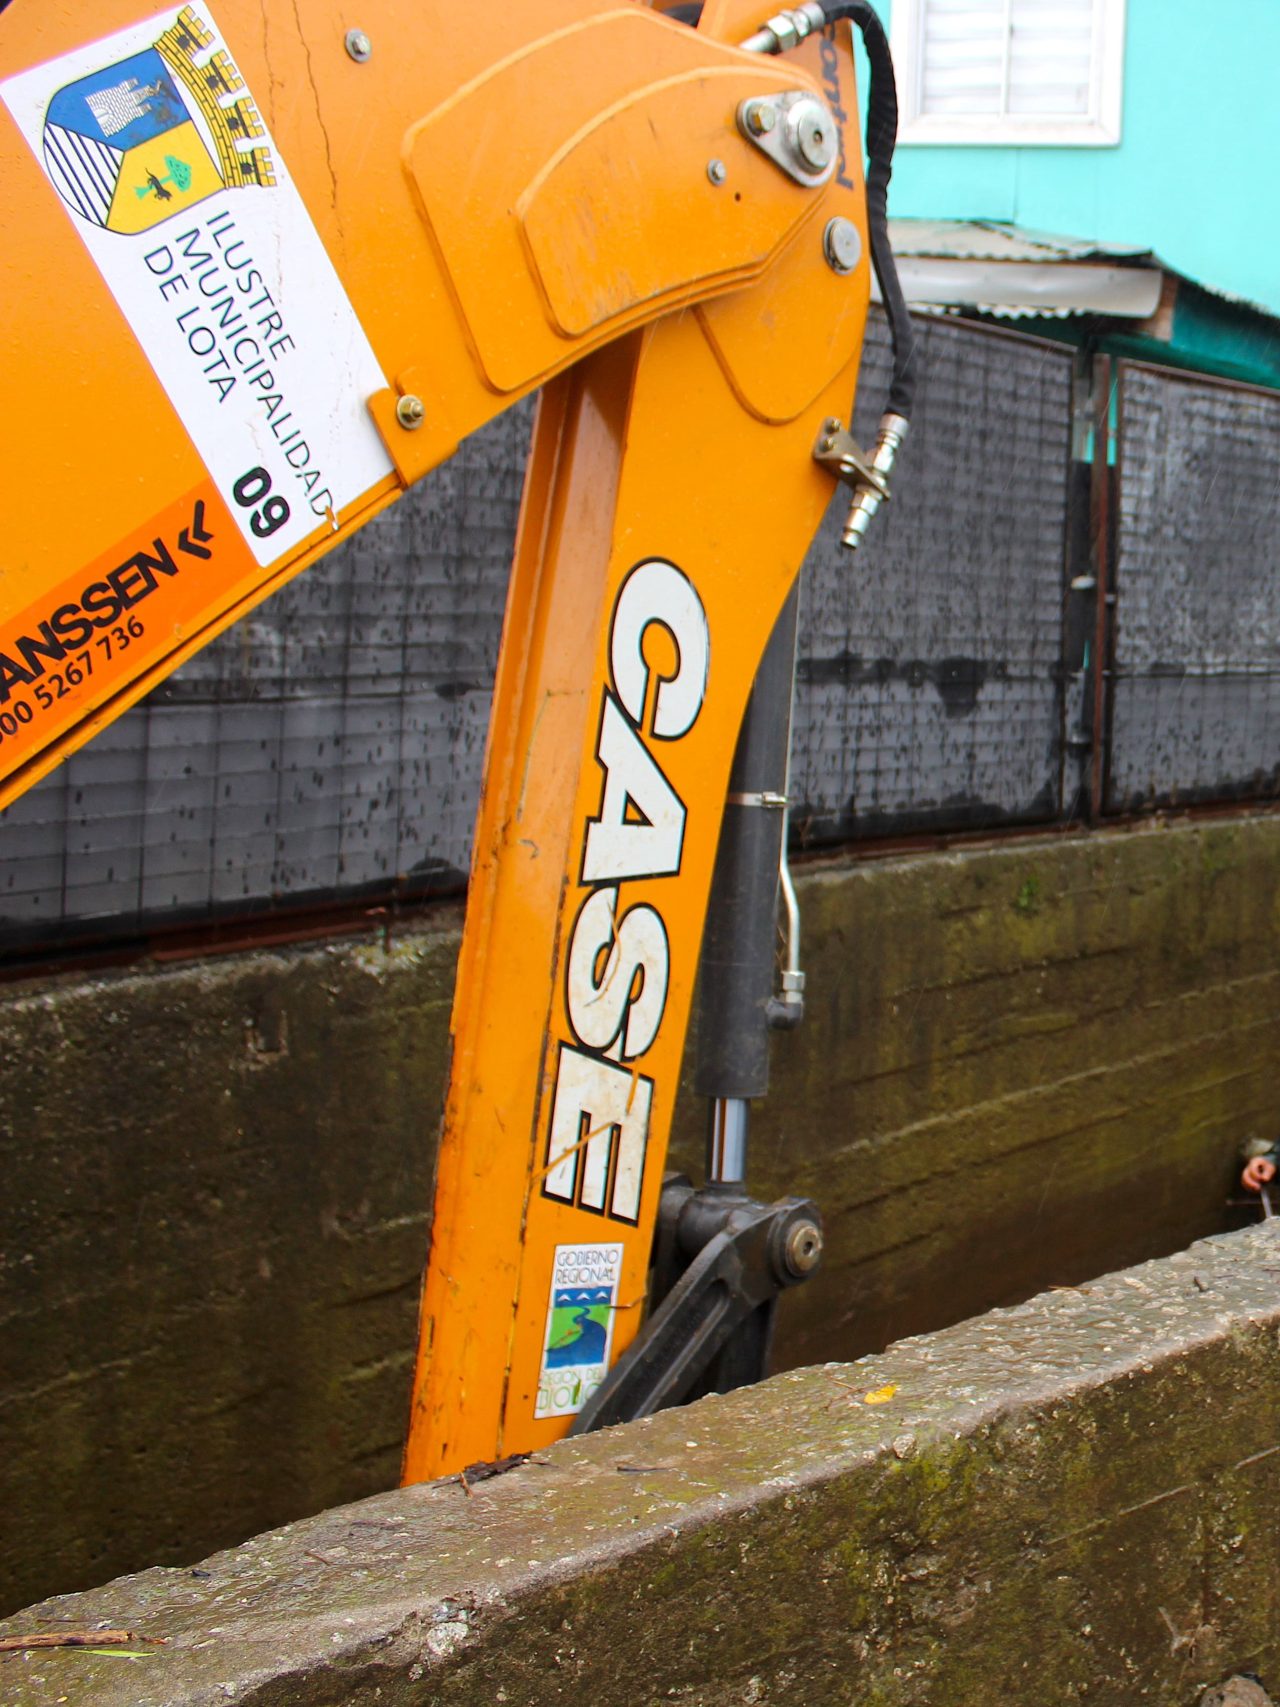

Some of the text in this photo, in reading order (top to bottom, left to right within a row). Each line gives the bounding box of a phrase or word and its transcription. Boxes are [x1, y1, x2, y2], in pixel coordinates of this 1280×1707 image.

[143, 245, 237, 403] DE LOTA
[206, 210, 296, 361] ILUSTRE
[175, 228, 334, 516] MUNICIPALIDAD
[232, 466, 291, 538] 09
[33, 650, 94, 710] 5267
[95, 615, 145, 661] 736
[541, 556, 710, 1228] CASE
[554, 1267, 616, 1285] REGIONAL
[556, 1249, 619, 1267] GOBIERNO
